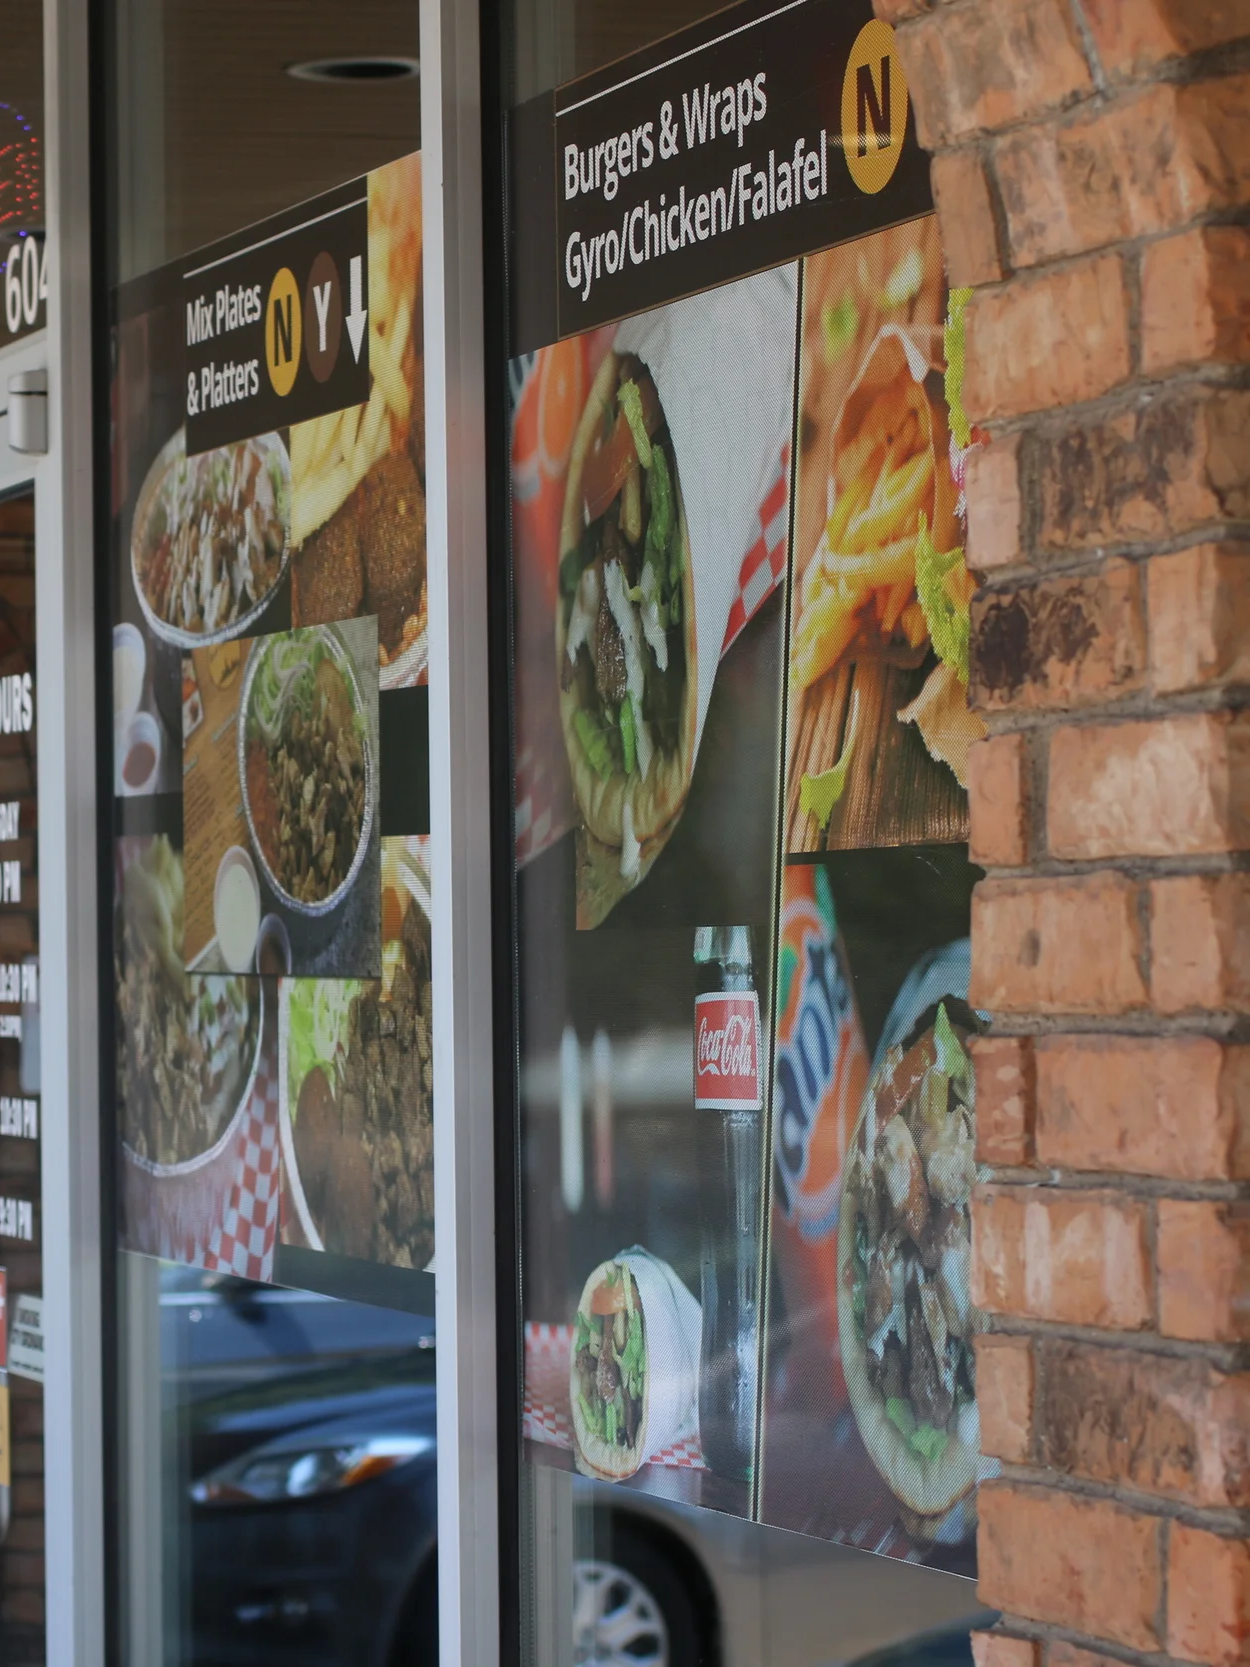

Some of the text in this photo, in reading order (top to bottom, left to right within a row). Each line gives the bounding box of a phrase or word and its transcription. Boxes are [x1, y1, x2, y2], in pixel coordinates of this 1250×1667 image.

[564, 72, 767, 200] Burgers & Wraps
[856, 55, 891, 158] N
[565, 129, 828, 301] Gyro/Chicken/Falafel
[186, 284, 262, 346] Mix Plates
[273, 294, 292, 367] N
[313, 280, 332, 352] Y
[186, 358, 259, 416] & Platters
[3, 860, 21, 904] PM
[697, 1014, 754, 1077] Coca-Cola
